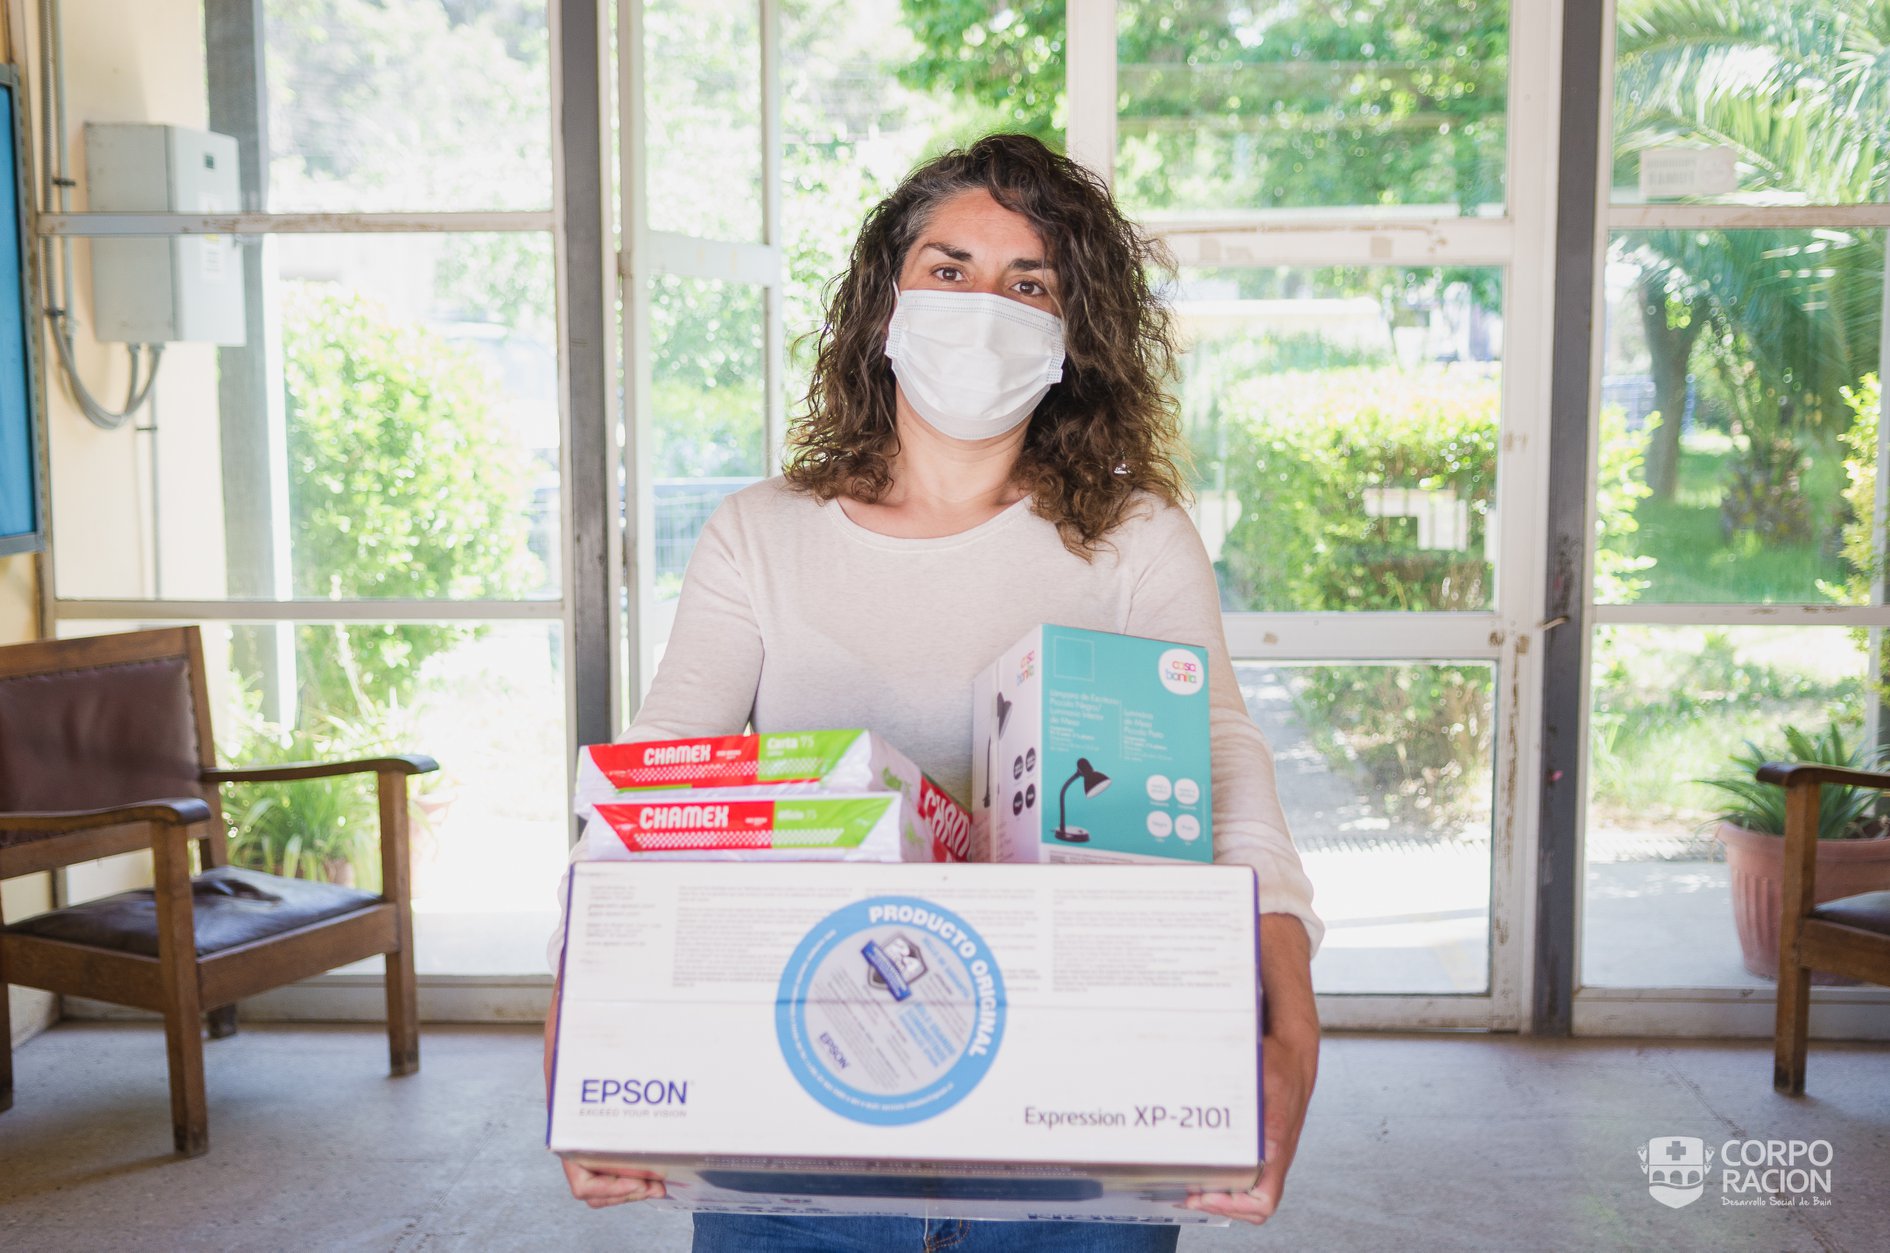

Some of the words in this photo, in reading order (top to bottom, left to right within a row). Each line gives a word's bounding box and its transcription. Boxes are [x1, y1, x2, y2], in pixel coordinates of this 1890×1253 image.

[643, 744, 712, 766] CHAMEX
[639, 805, 730, 830] CHAMEX
[923, 787, 971, 858] CHAM
[867, 904, 977, 959] PRODUCTO
[968, 959, 998, 1058] ORIGINAL
[818, 1032, 850, 1070] EPSON
[580, 1079, 688, 1105] EPSON
[578, 1108, 620, 1118] EXCEED
[622, 1108, 650, 1118] YOUR
[652, 1109, 688, 1118] VISION
[1024, 1106, 1126, 1130] Expression
[1134, 1105, 1231, 1129] XP-2101
